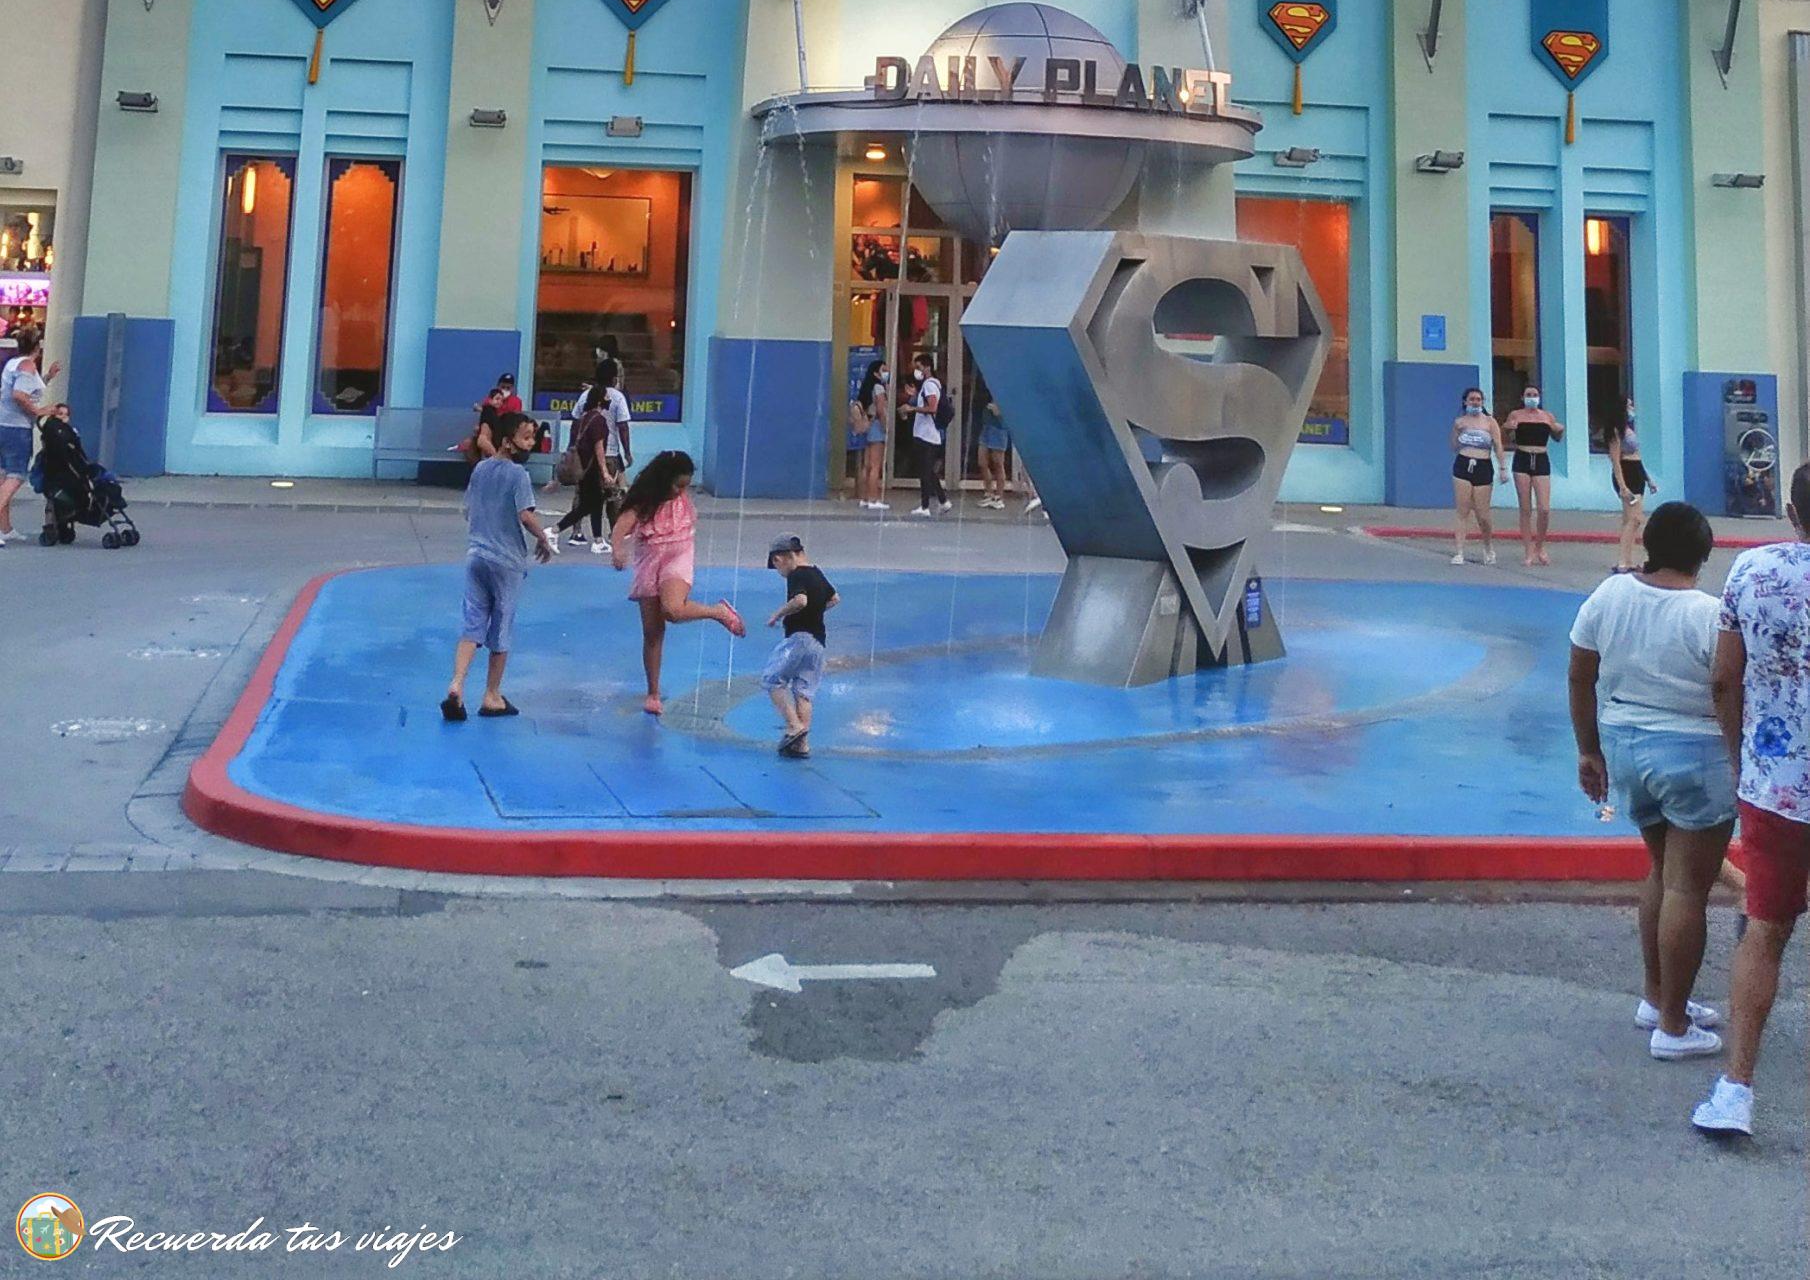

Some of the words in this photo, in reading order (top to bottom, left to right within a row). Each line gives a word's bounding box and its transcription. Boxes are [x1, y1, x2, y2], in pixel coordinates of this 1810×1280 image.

[874, 55, 1028, 101] DAILY
[1044, 57, 1232, 116] PLANET
[550, 399, 575, 411] DAI
